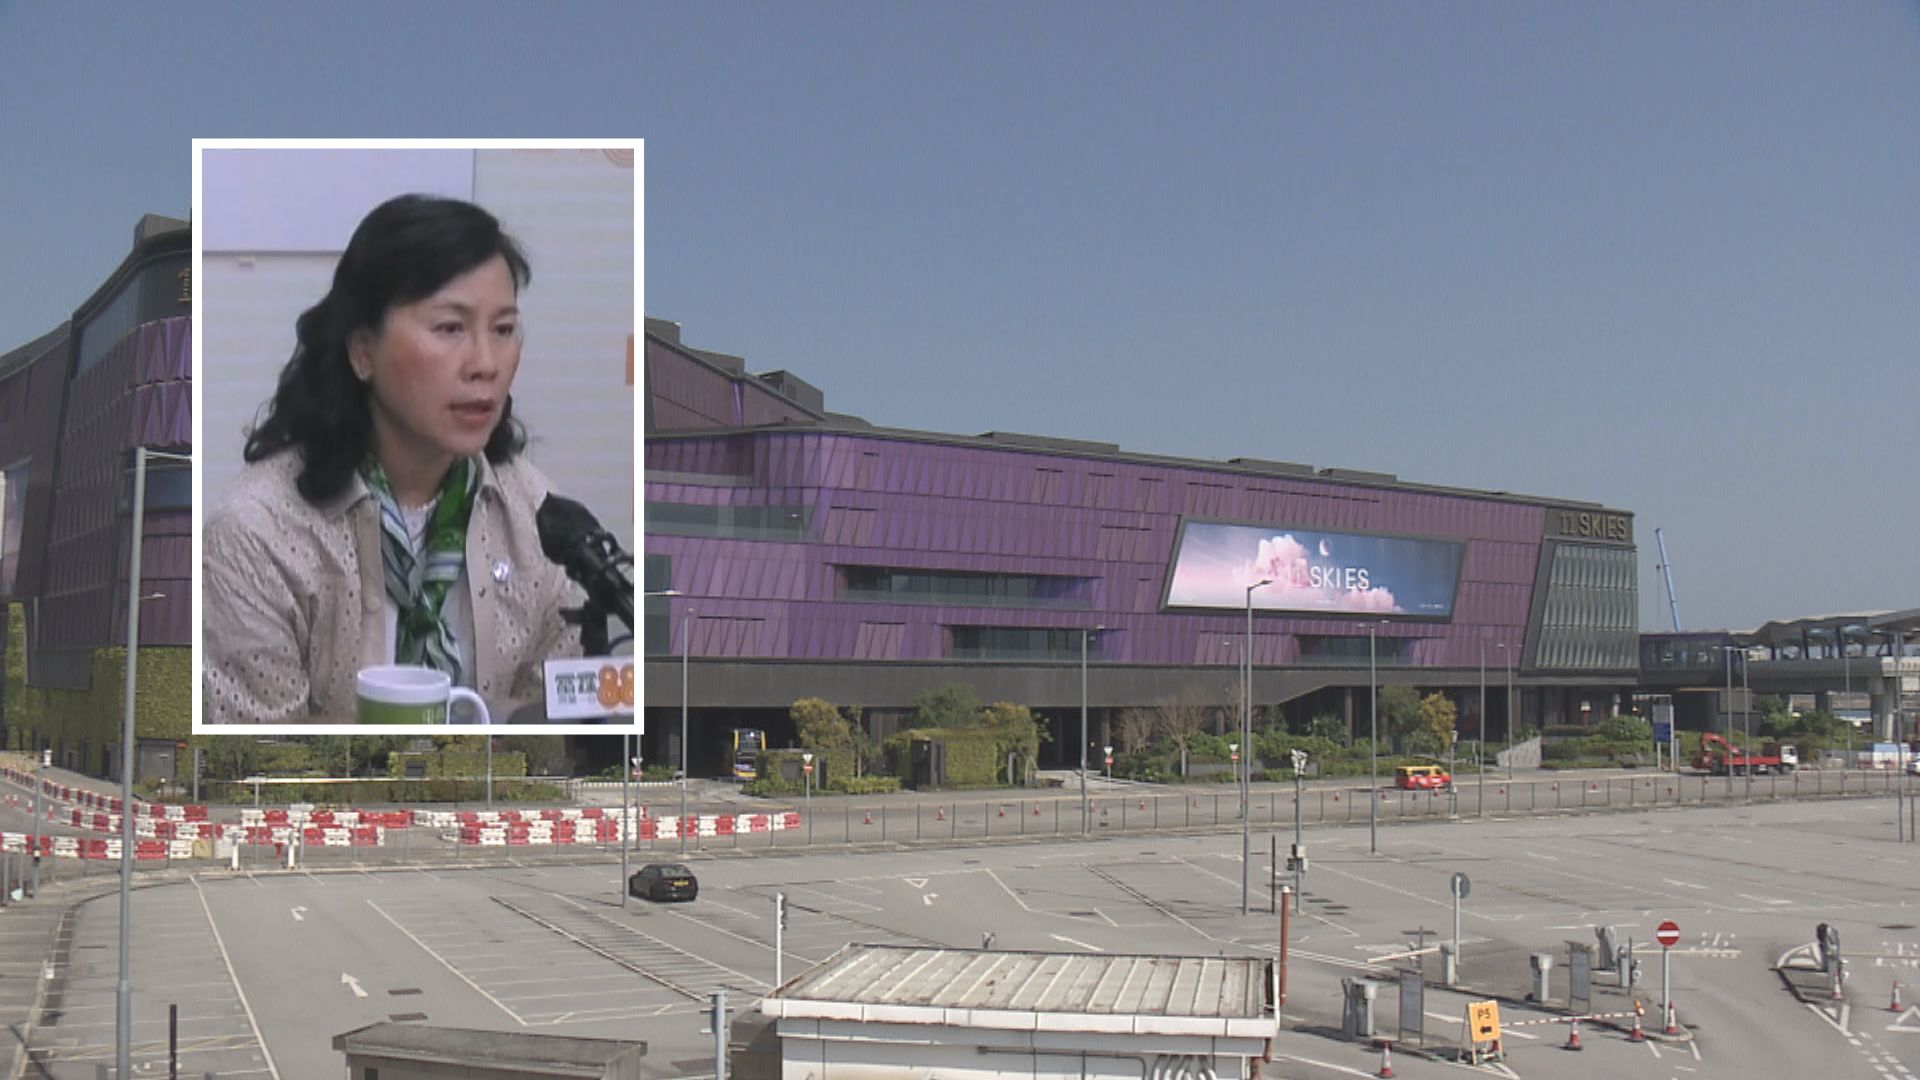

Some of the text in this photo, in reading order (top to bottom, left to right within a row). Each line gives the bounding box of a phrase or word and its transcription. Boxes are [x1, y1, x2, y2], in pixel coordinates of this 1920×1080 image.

[1560, 511, 1626, 541] 11 SKIES
[1310, 566, 1369, 589] SKIES
[1477, 1008, 1491, 1019] P5
